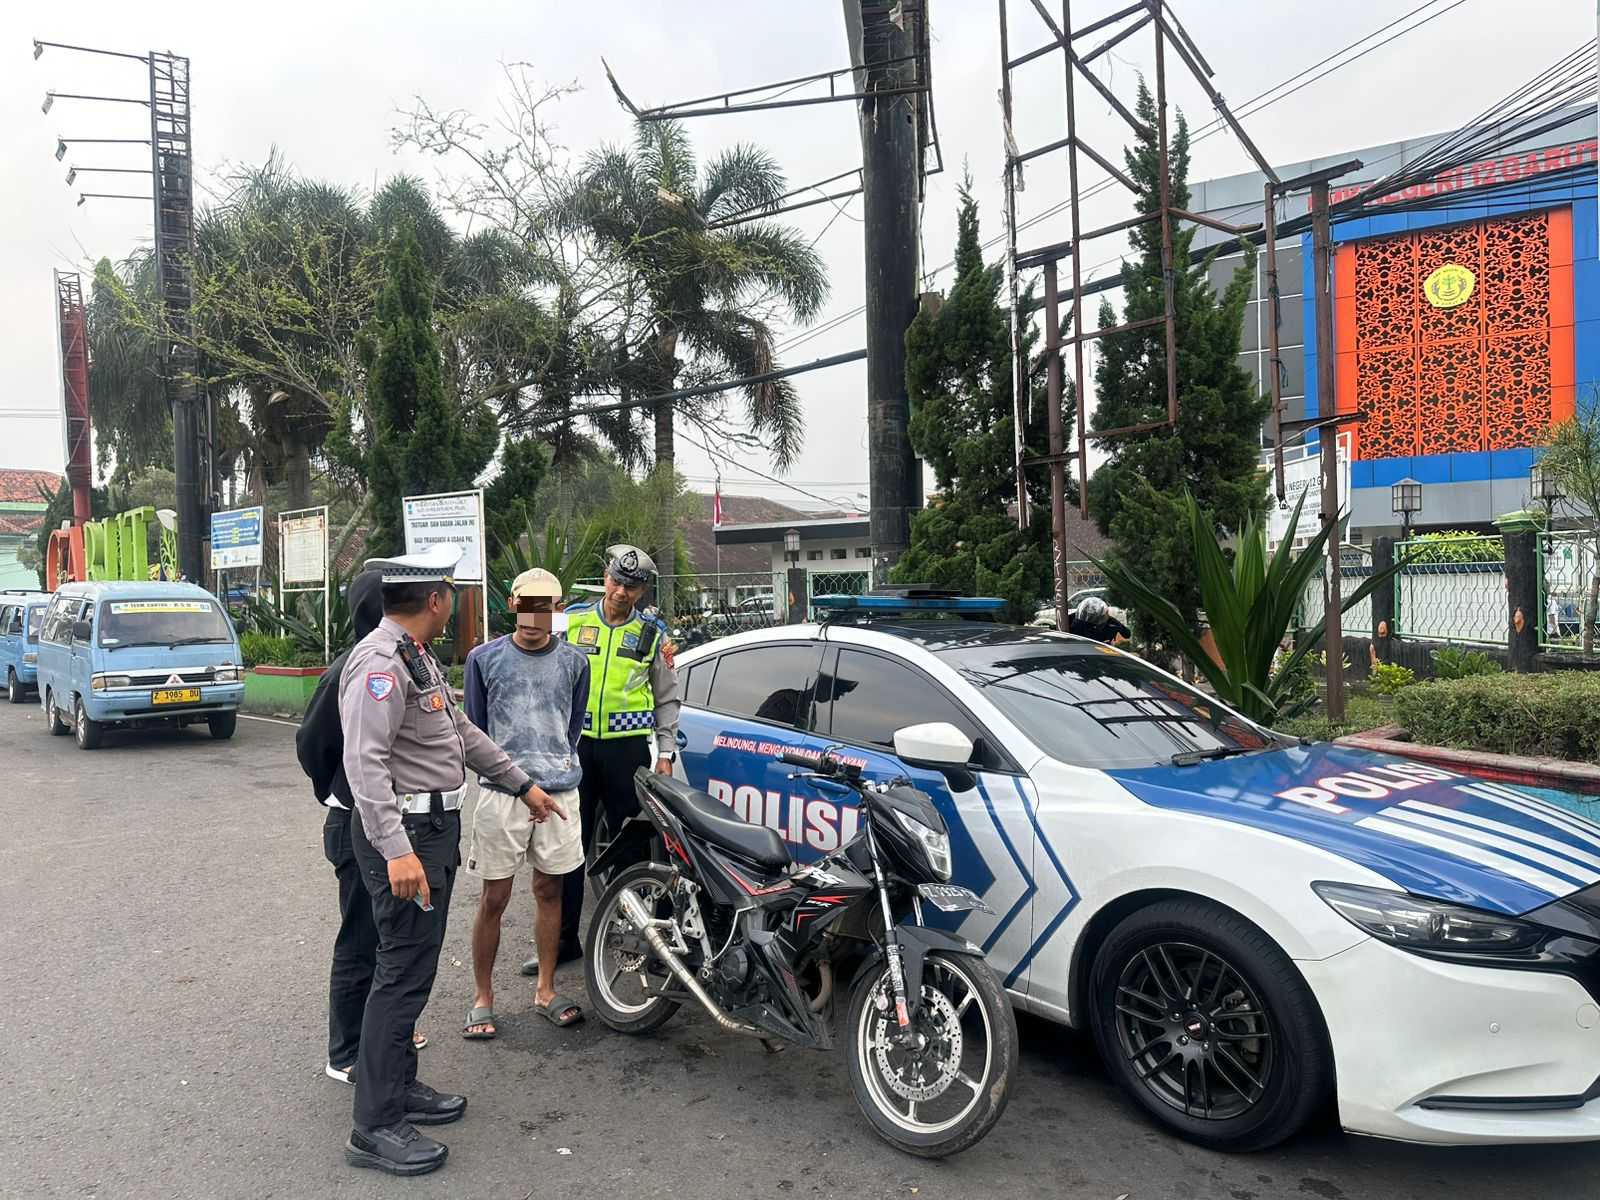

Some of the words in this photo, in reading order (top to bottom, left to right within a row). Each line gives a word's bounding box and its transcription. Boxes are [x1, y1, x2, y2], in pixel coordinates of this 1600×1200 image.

[154, 692, 159, 700] Z
[165, 691, 183, 699] 1985
[707, 778, 860, 852] POLISI
[1273, 762, 1467, 815] POLISI
